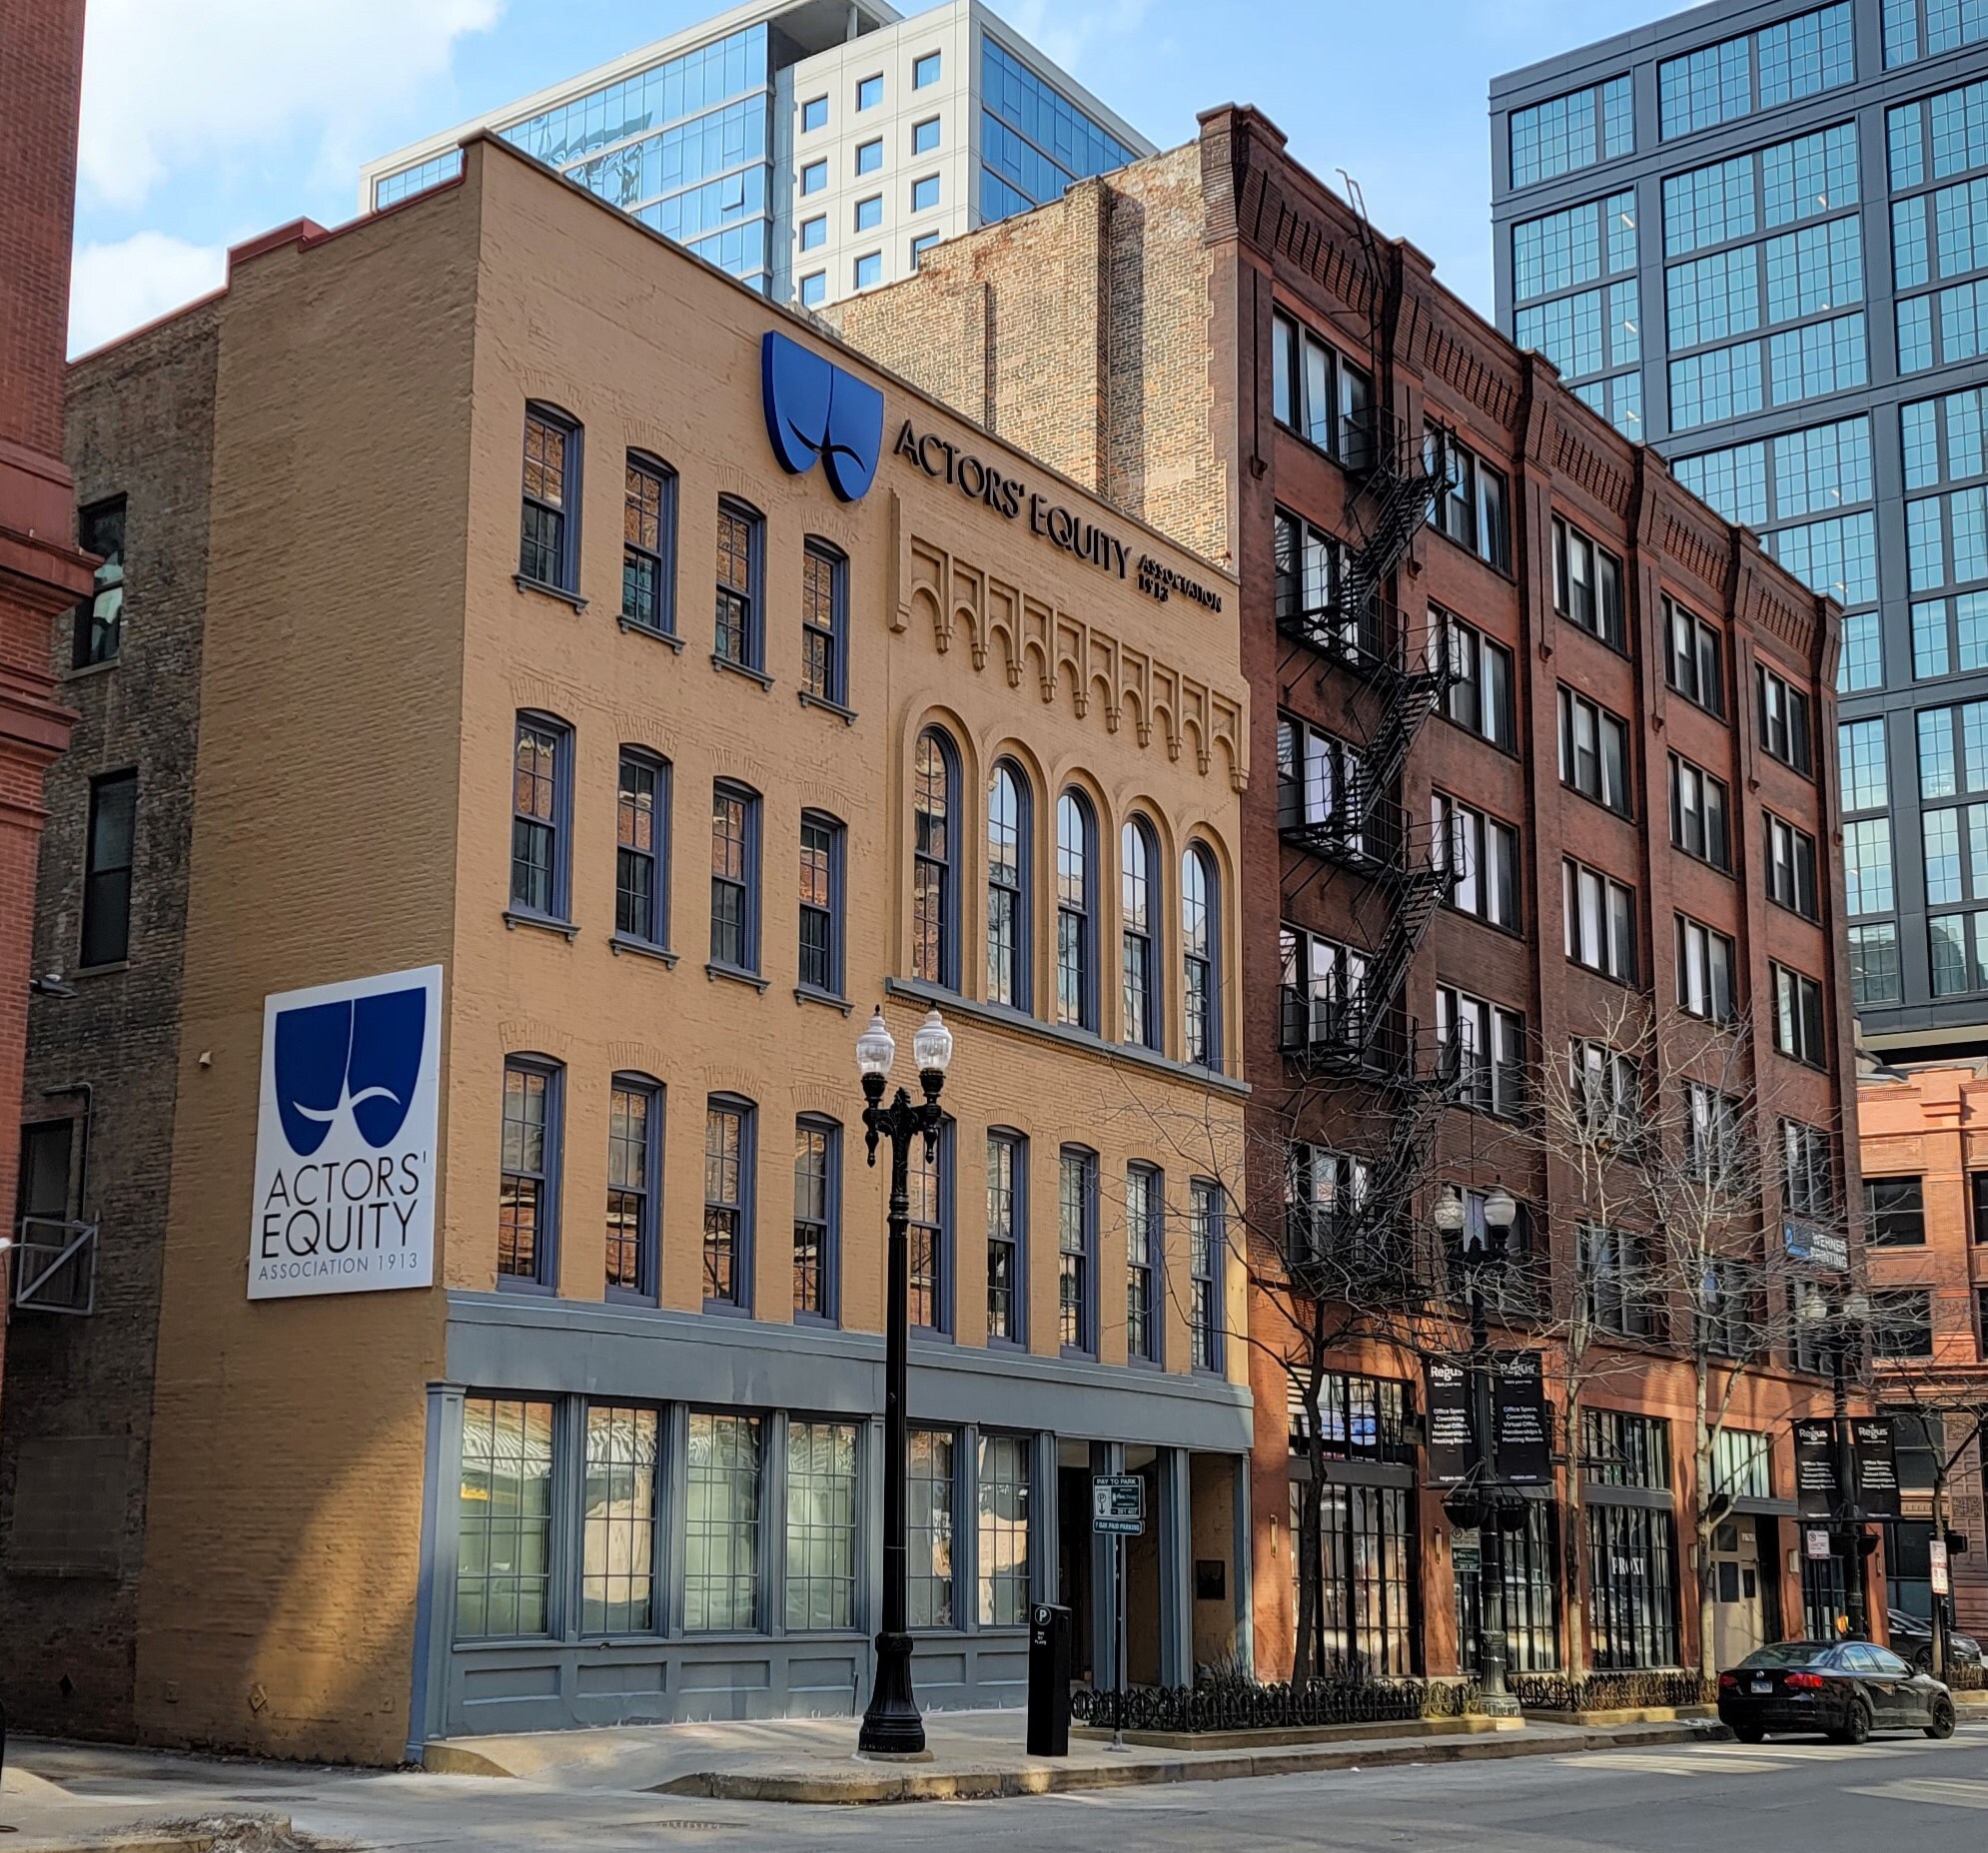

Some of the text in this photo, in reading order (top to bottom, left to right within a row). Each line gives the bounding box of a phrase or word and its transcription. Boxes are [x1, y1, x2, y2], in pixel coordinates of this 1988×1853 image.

[893, 419, 1132, 579] ACTORS' EQUITY
[1137, 553, 1222, 613] ASSOCIATION
[1138, 573, 1169, 602] 1913
[264, 1151, 427, 1210] ACTORS'
[262, 1199, 418, 1259] EQUITY
[258, 1252, 418, 1281] ASSOCIATION 1913
[1431, 1366, 1464, 1382] Regus
[1798, 1428, 1828, 1441] Regus
[1857, 1426, 1888, 1439] Regus
